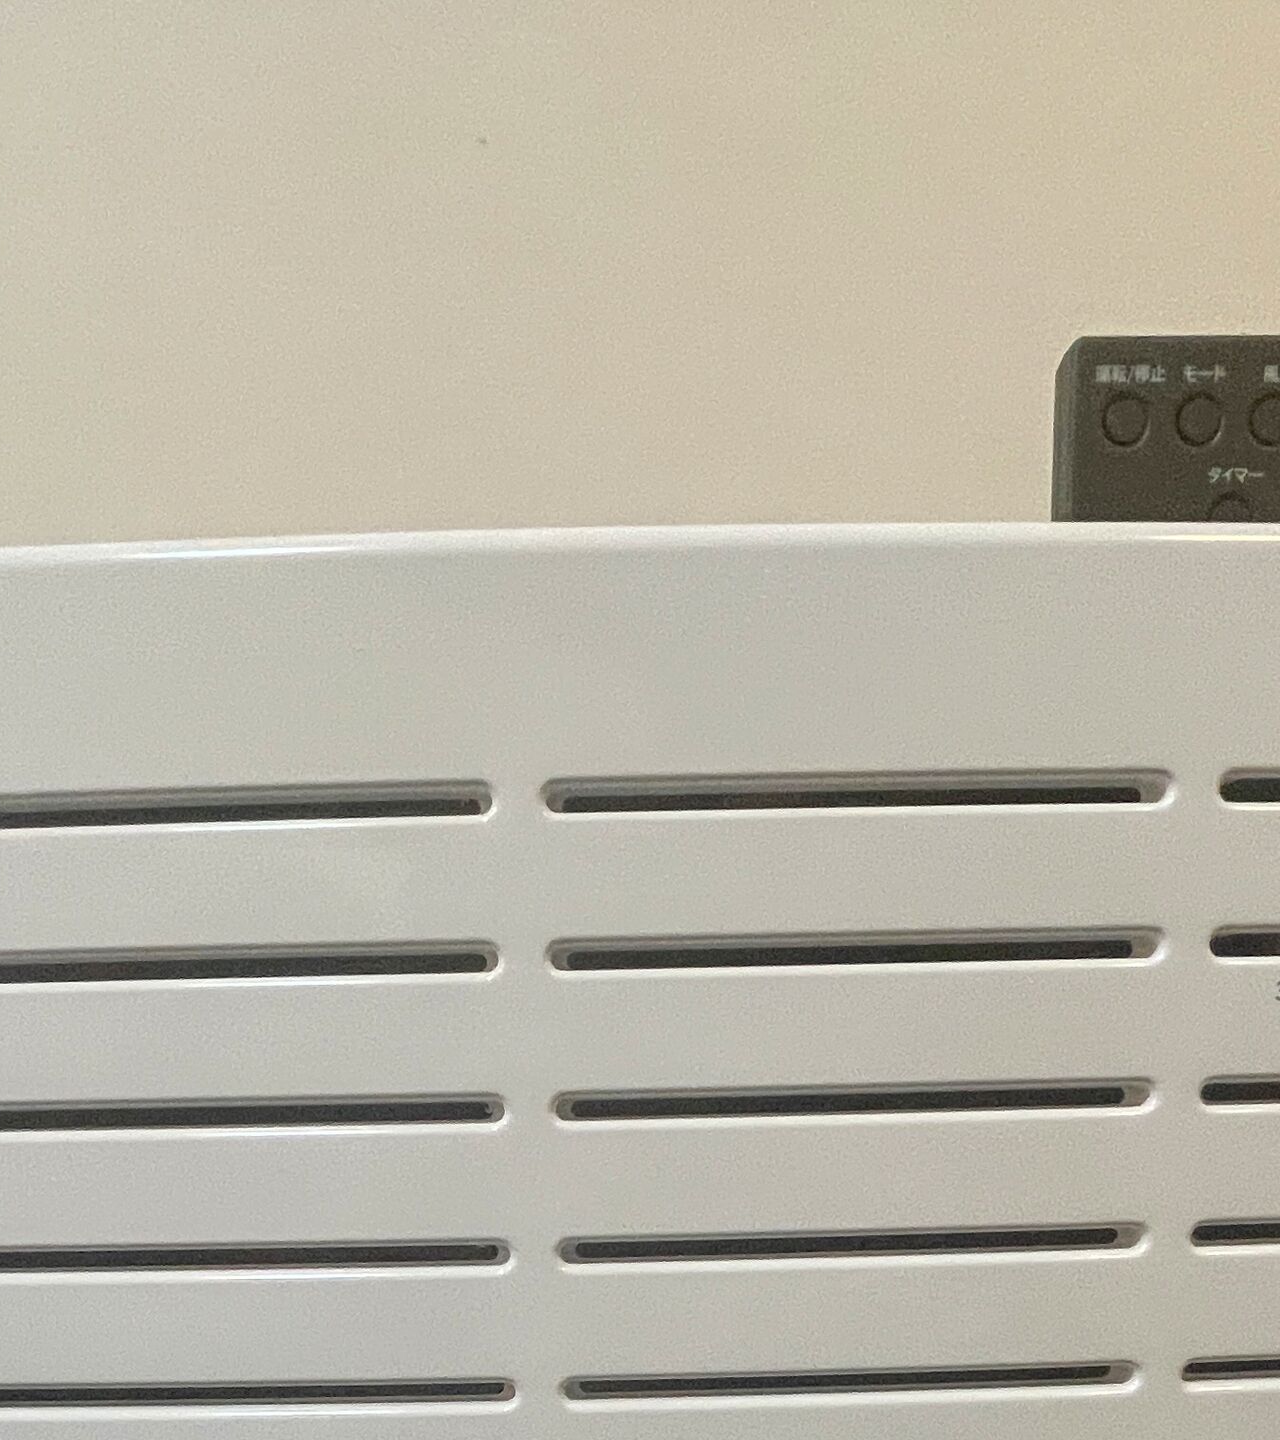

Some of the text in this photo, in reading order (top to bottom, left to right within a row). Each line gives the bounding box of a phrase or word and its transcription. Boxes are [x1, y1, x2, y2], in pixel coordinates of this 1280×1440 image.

[1183, 364, 1227, 384] モード
[1207, 466, 1265, 484] タイマー
